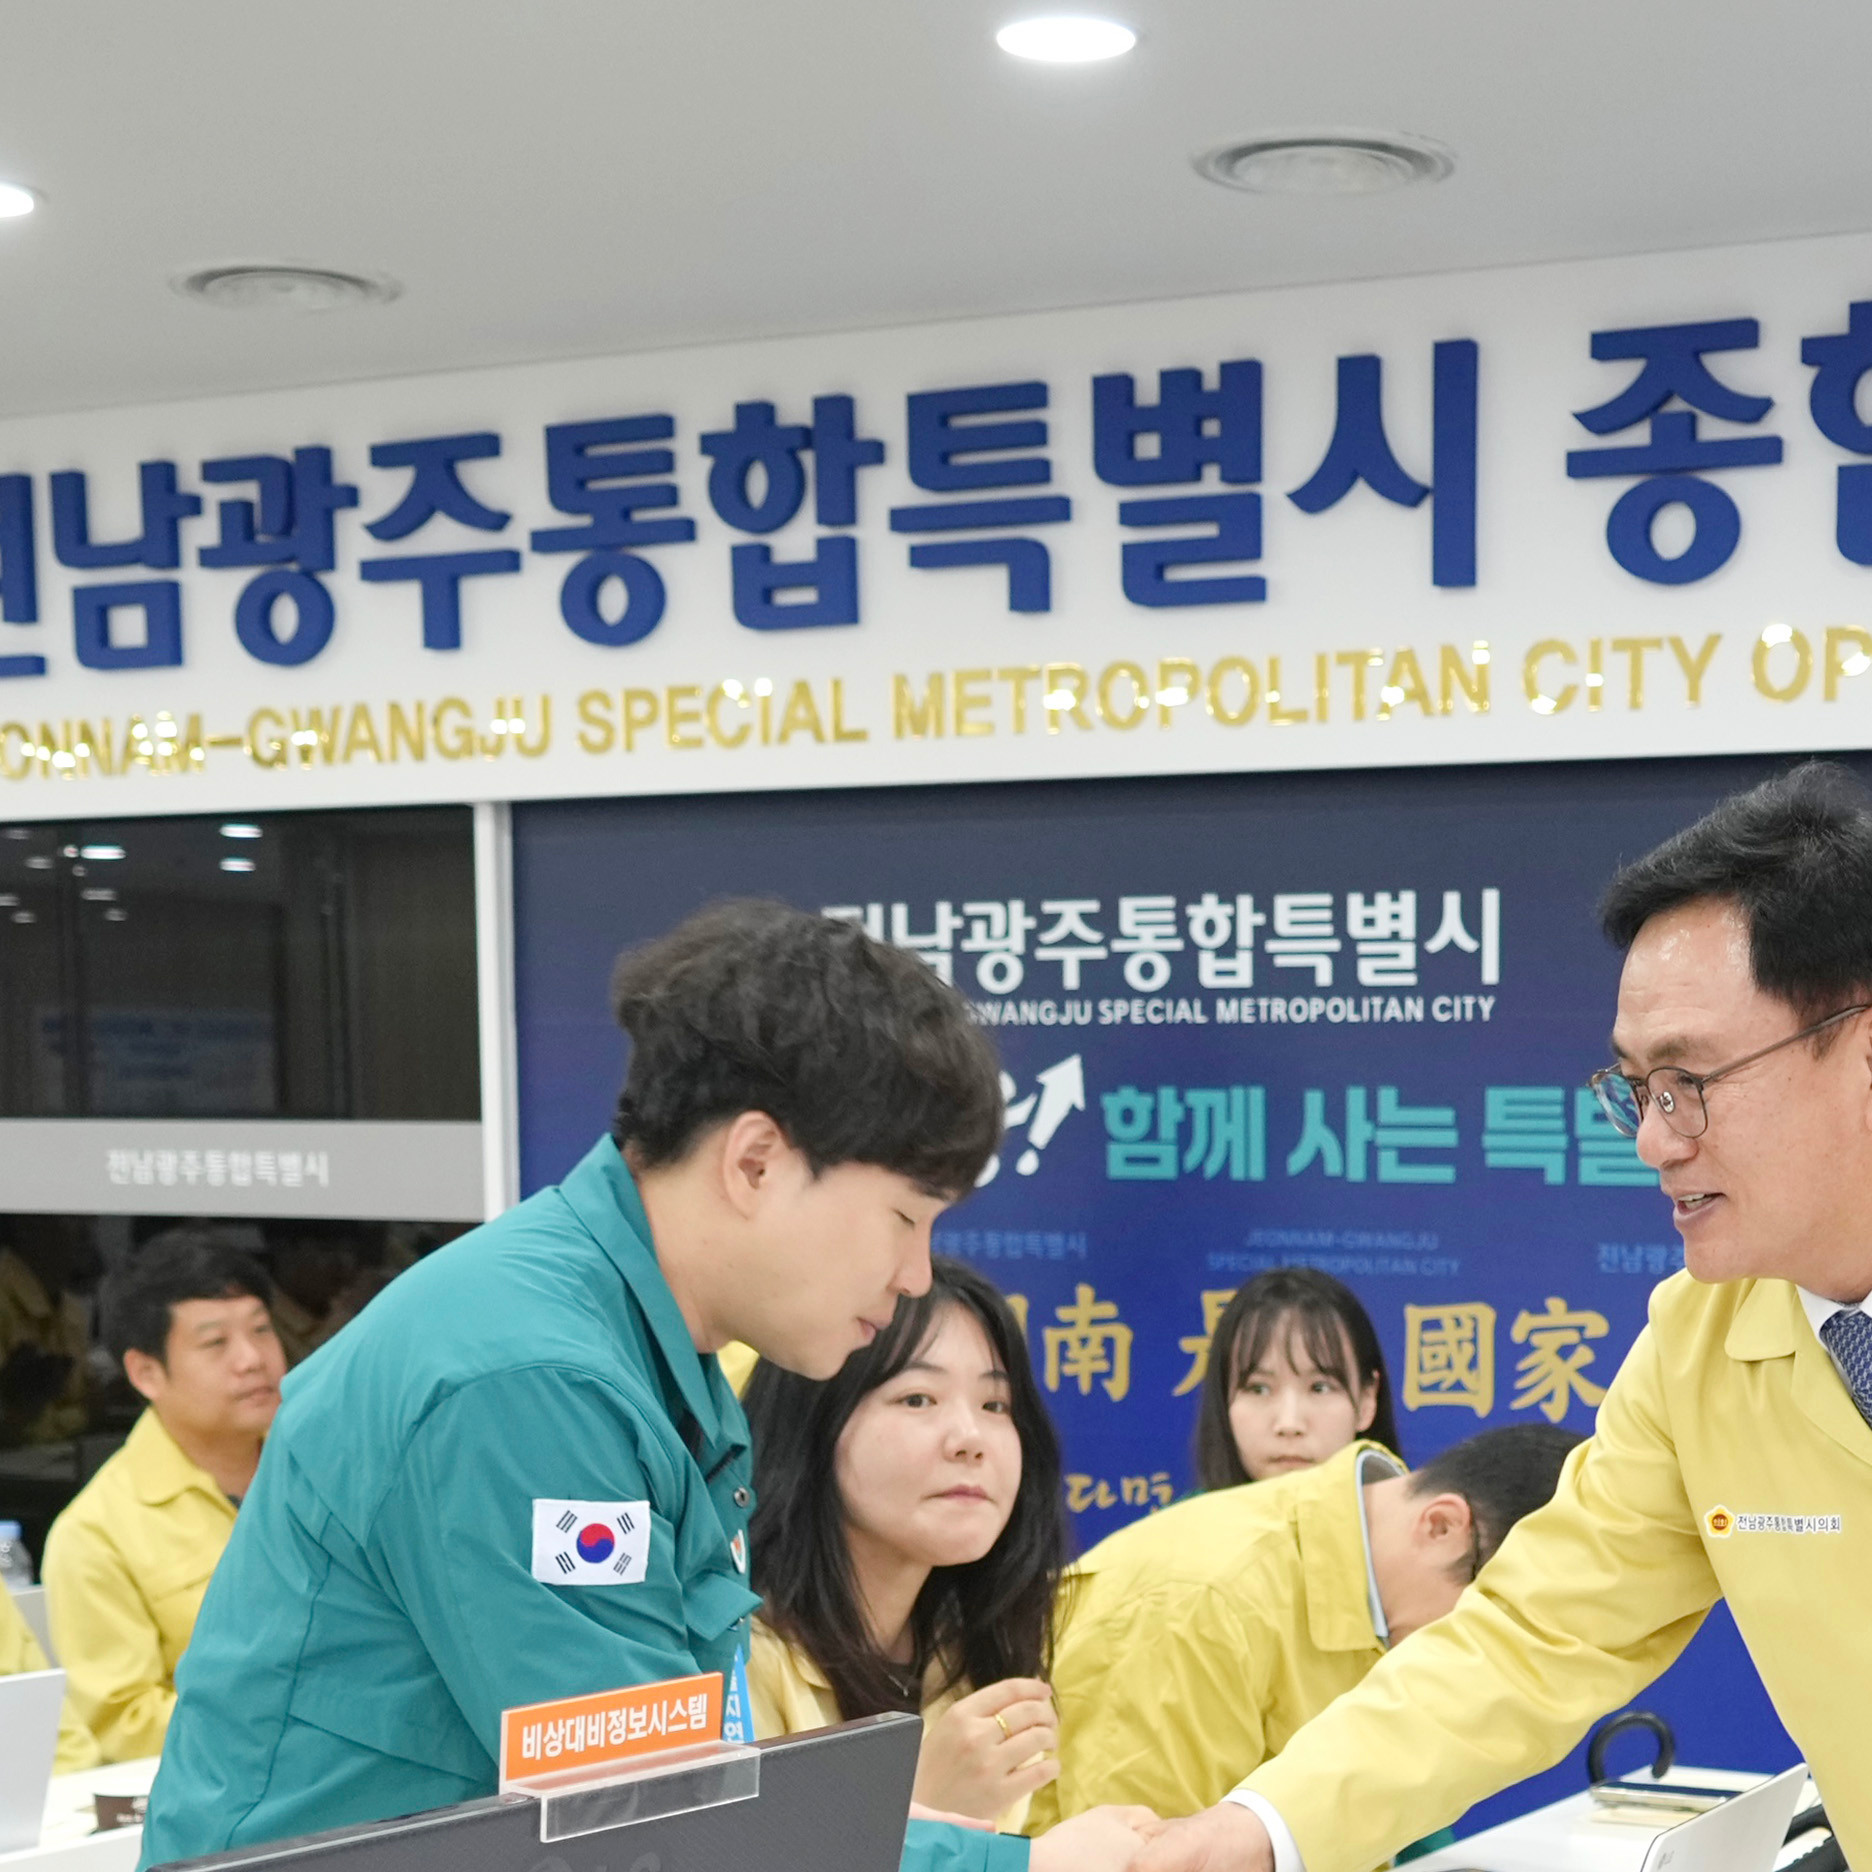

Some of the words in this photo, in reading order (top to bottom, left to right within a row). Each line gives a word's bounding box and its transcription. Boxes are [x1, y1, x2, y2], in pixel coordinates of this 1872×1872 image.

[576, 676, 865, 757] SPECIAL
[889, 643, 1492, 740] METROPOLITAN
[1520, 633, 1723, 715] CITY
[1098, 998, 1208, 1025] SPECIAL
[1215, 996, 1425, 1024] METROPOLITAN
[1431, 995, 1496, 1022] CITY
[1101, 1085, 1268, 1181] 함께
[1286, 1085, 1460, 1183] 사는
[521, 1693, 708, 1760] 비상대비정보시스템
